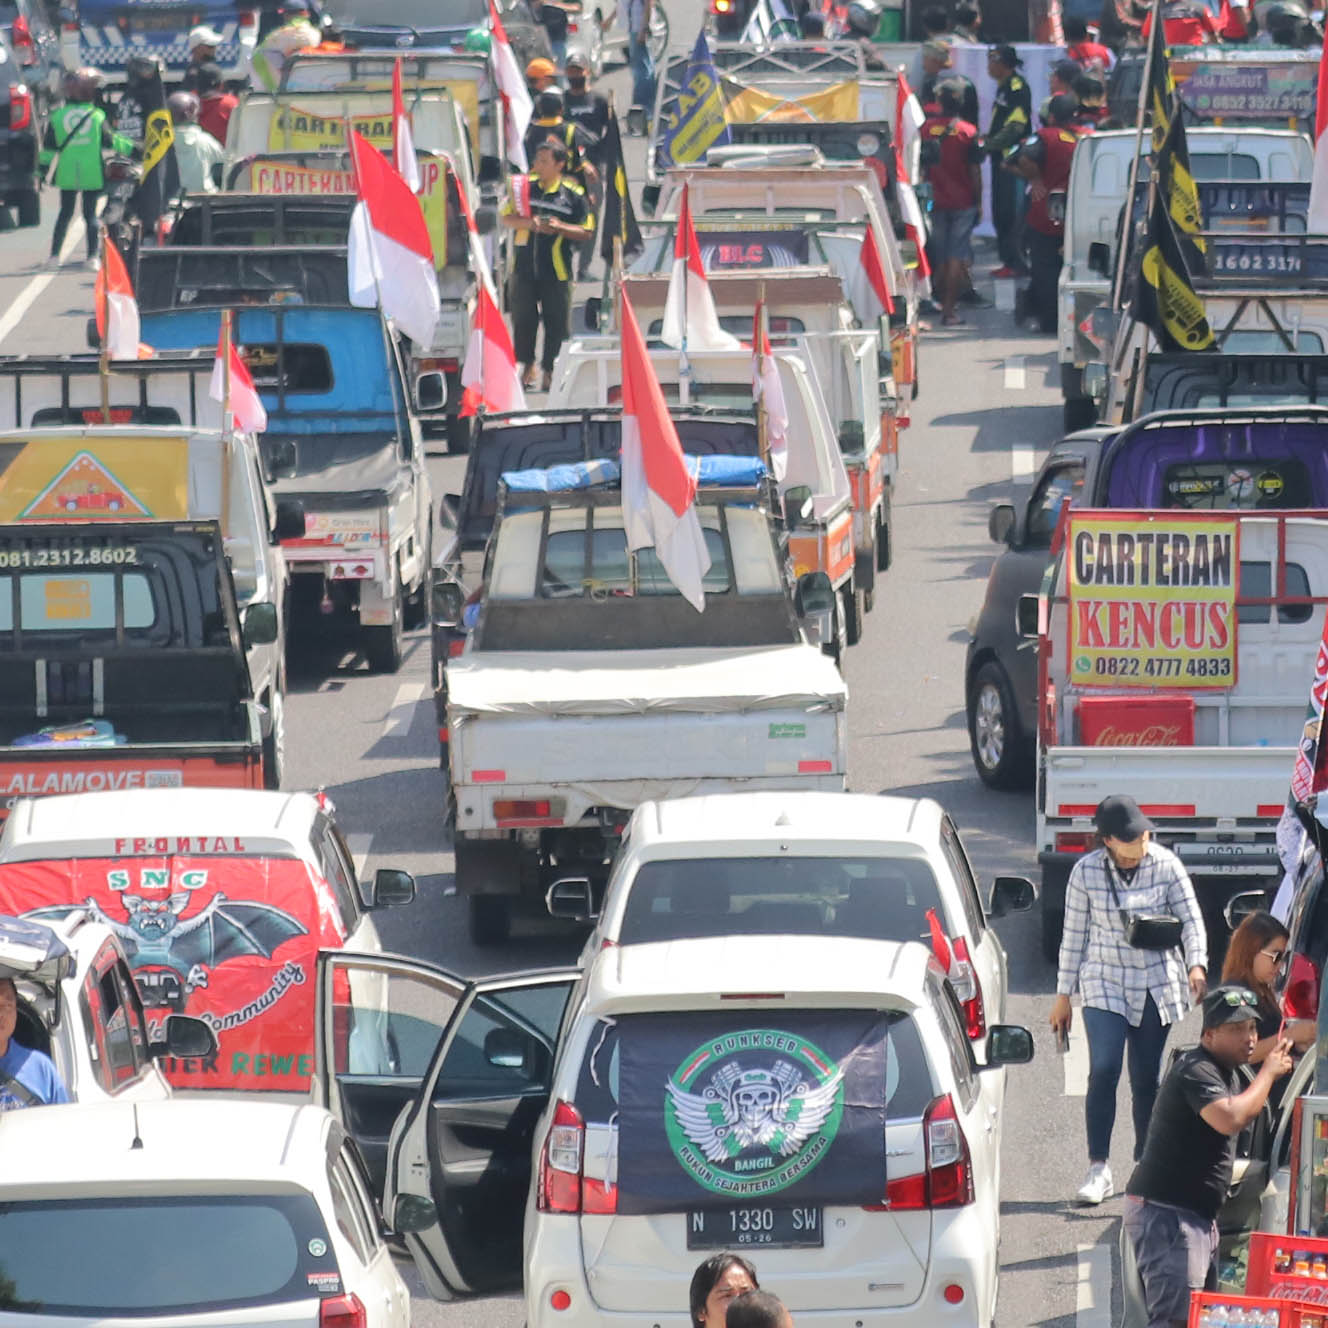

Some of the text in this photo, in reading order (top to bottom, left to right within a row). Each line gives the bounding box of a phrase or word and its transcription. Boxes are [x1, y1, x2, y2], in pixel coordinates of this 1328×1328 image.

[1076, 532, 1232, 586] CARTERAN
[1077, 601, 1230, 650] KENCUS
[1096, 657, 1231, 677] 0822 4777 4833
[0, 772, 145, 793] ALAMOVE
[714, 1034, 799, 1057] RUNKSEB
[681, 1135, 829, 1195] RUKUN SEJAHTERA BERSAMA
[735, 1157, 776, 1171] BANGIL
[694, 1208, 818, 1232] N 1330 SW
